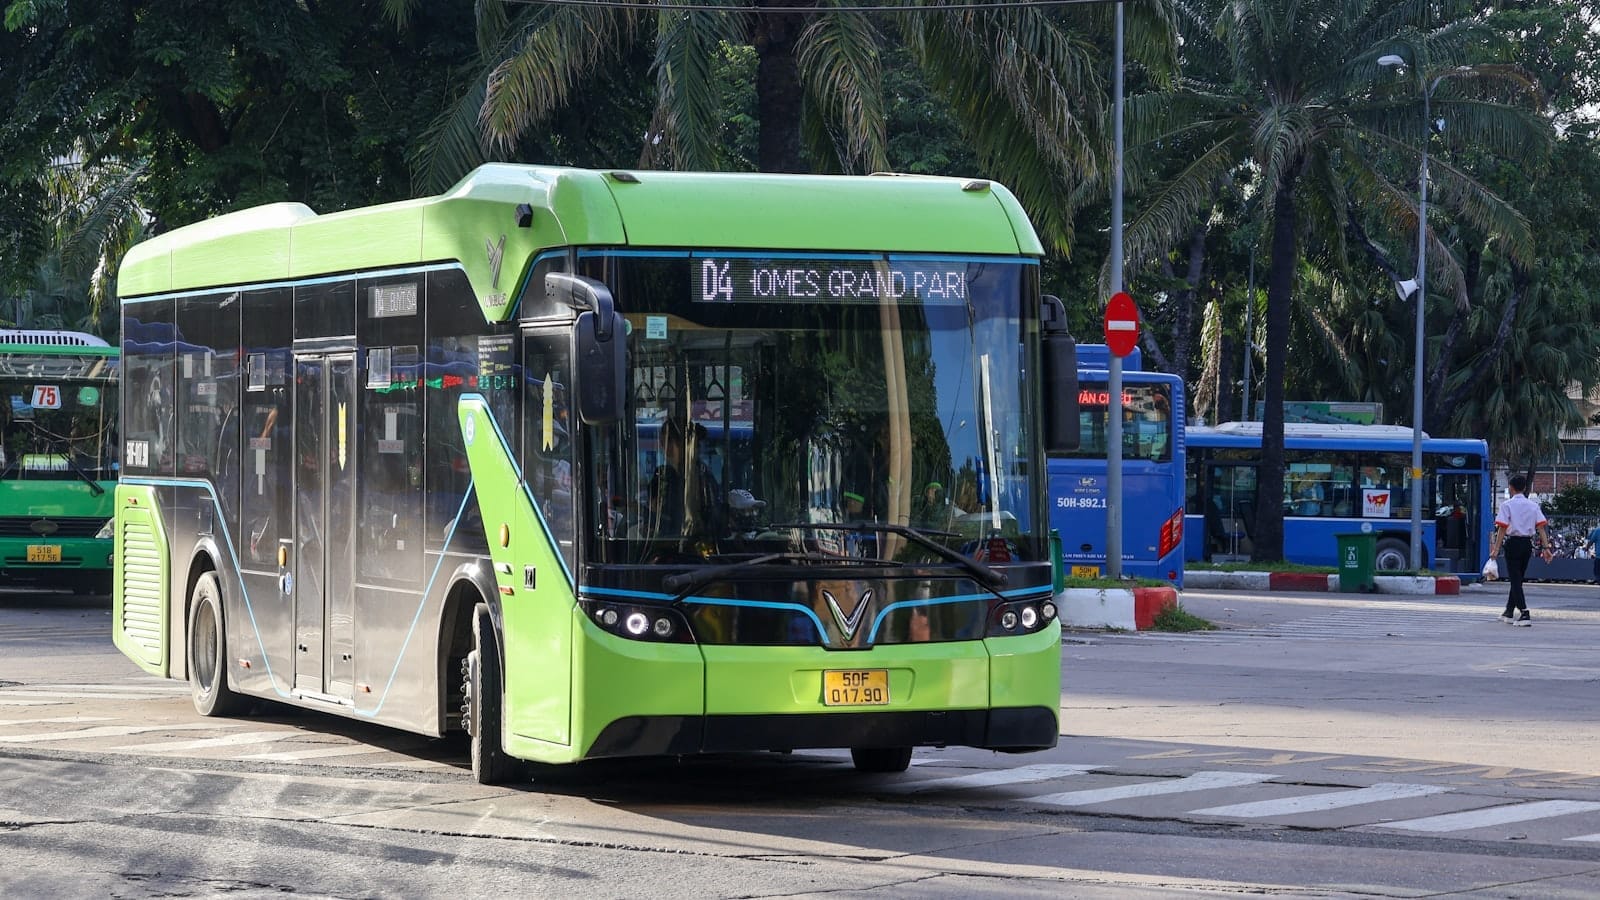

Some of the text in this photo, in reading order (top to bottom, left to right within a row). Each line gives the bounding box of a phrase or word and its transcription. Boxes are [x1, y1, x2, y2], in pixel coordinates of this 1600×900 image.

[702, 260, 734, 301] D4
[828, 270, 906, 298] GRAND
[37, 386, 57, 406] 75
[1057, 497, 1107, 508] 50H-892.1
[842, 672, 870, 687] 50F
[831, 687, 882, 703] 017.90
